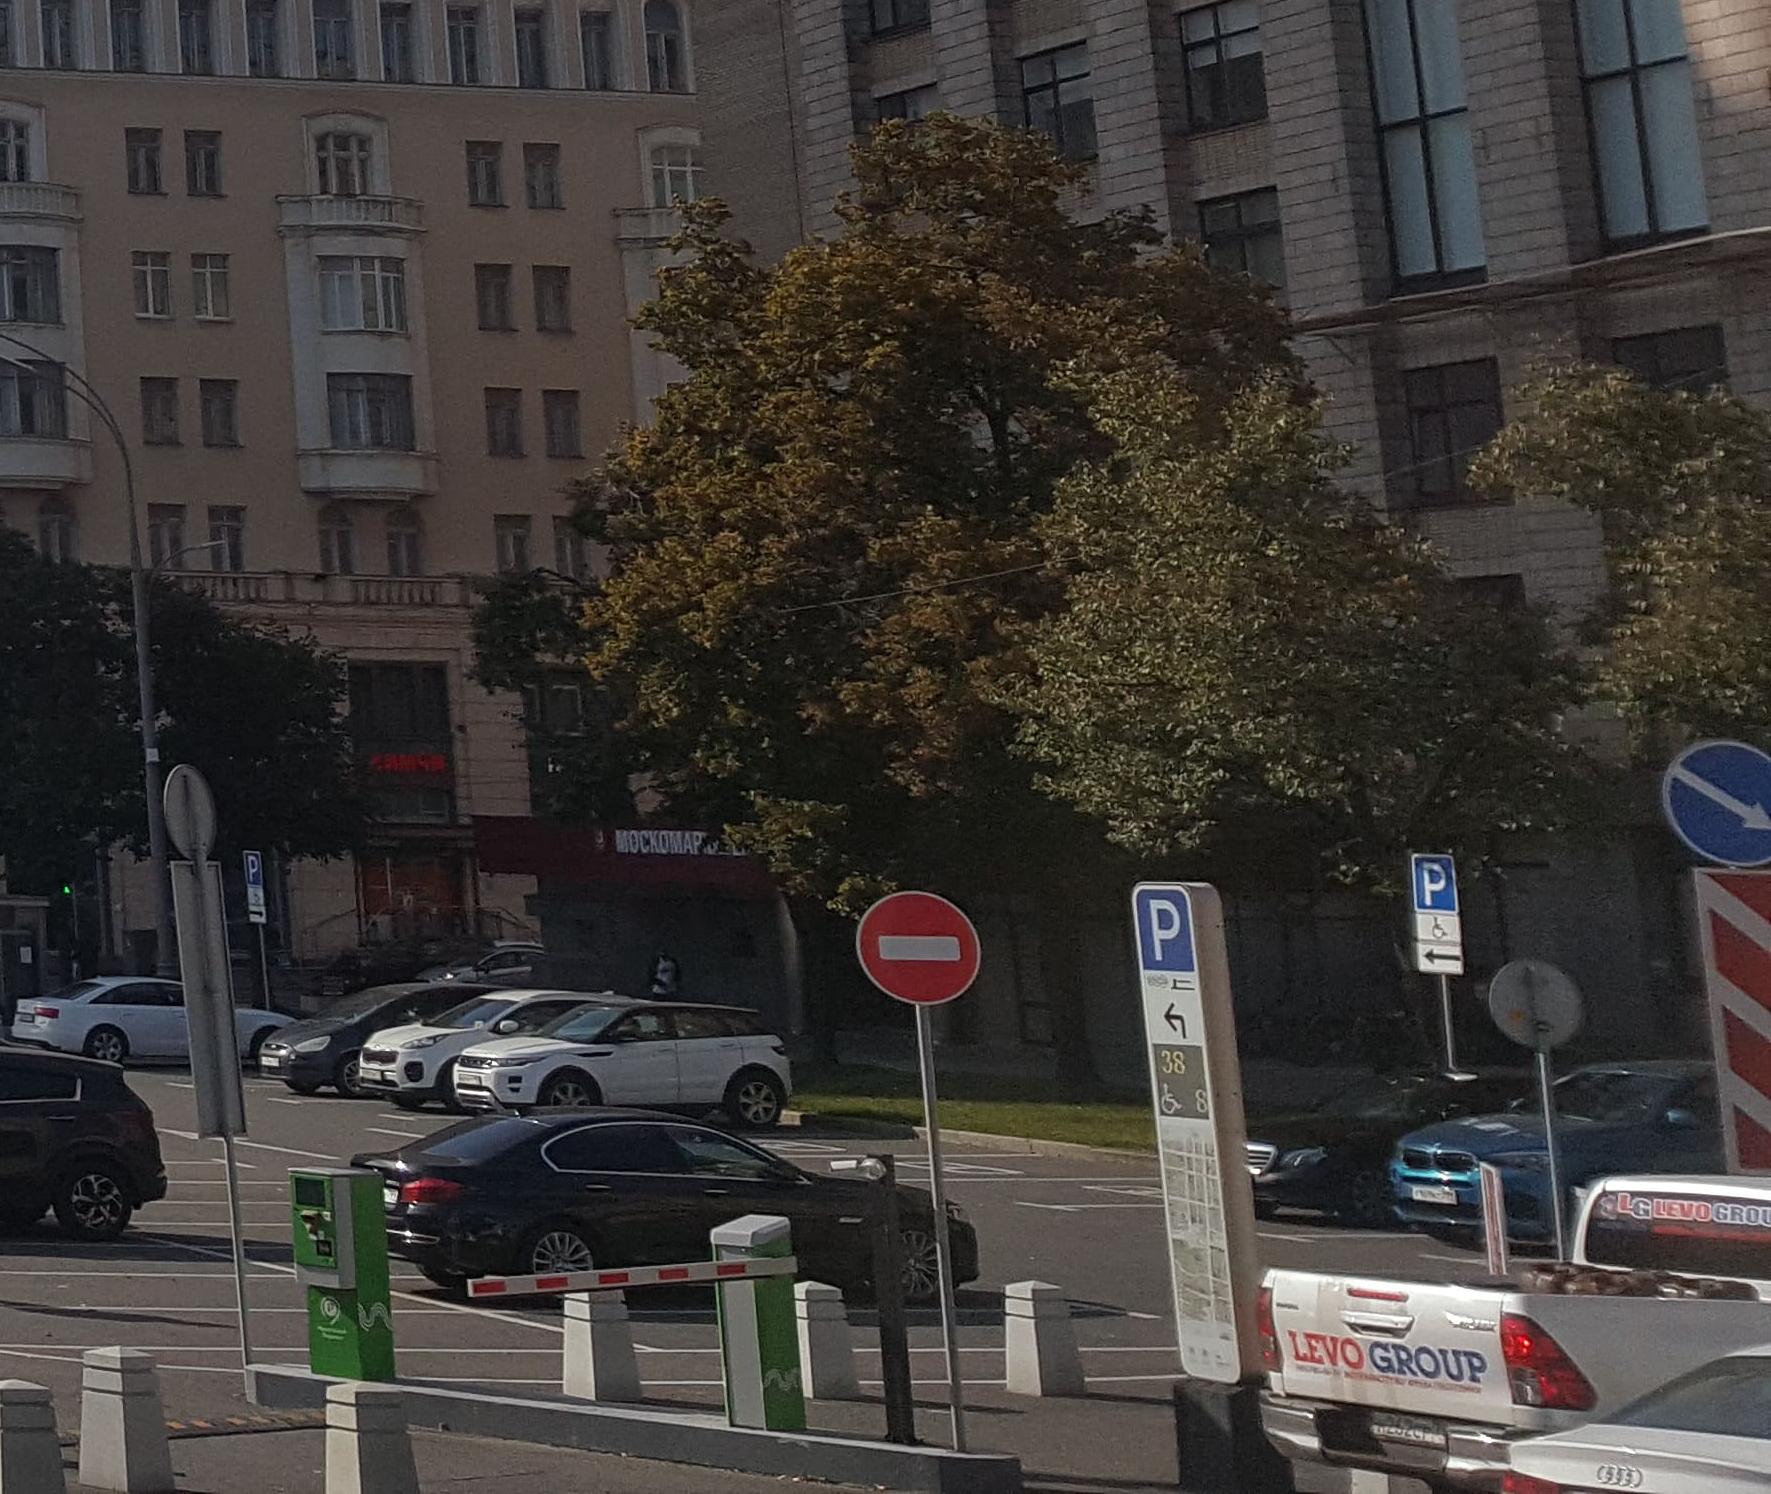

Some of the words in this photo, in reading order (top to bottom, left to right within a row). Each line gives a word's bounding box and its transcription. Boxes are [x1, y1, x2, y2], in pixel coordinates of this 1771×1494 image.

[248, 855, 258, 882] P
[1423, 863, 1446, 906] P
[1149, 899, 1181, 961] P
[1161, 1051, 1185, 1074] 38
[1195, 1089, 1207, 1112] 8
[1653, 1198, 1711, 1222] LEVO
[1712, 1203, 1771, 1226] GROU
[1288, 1330, 1365, 1370] LEVO
[1368, 1341, 1488, 1384] GROUP
